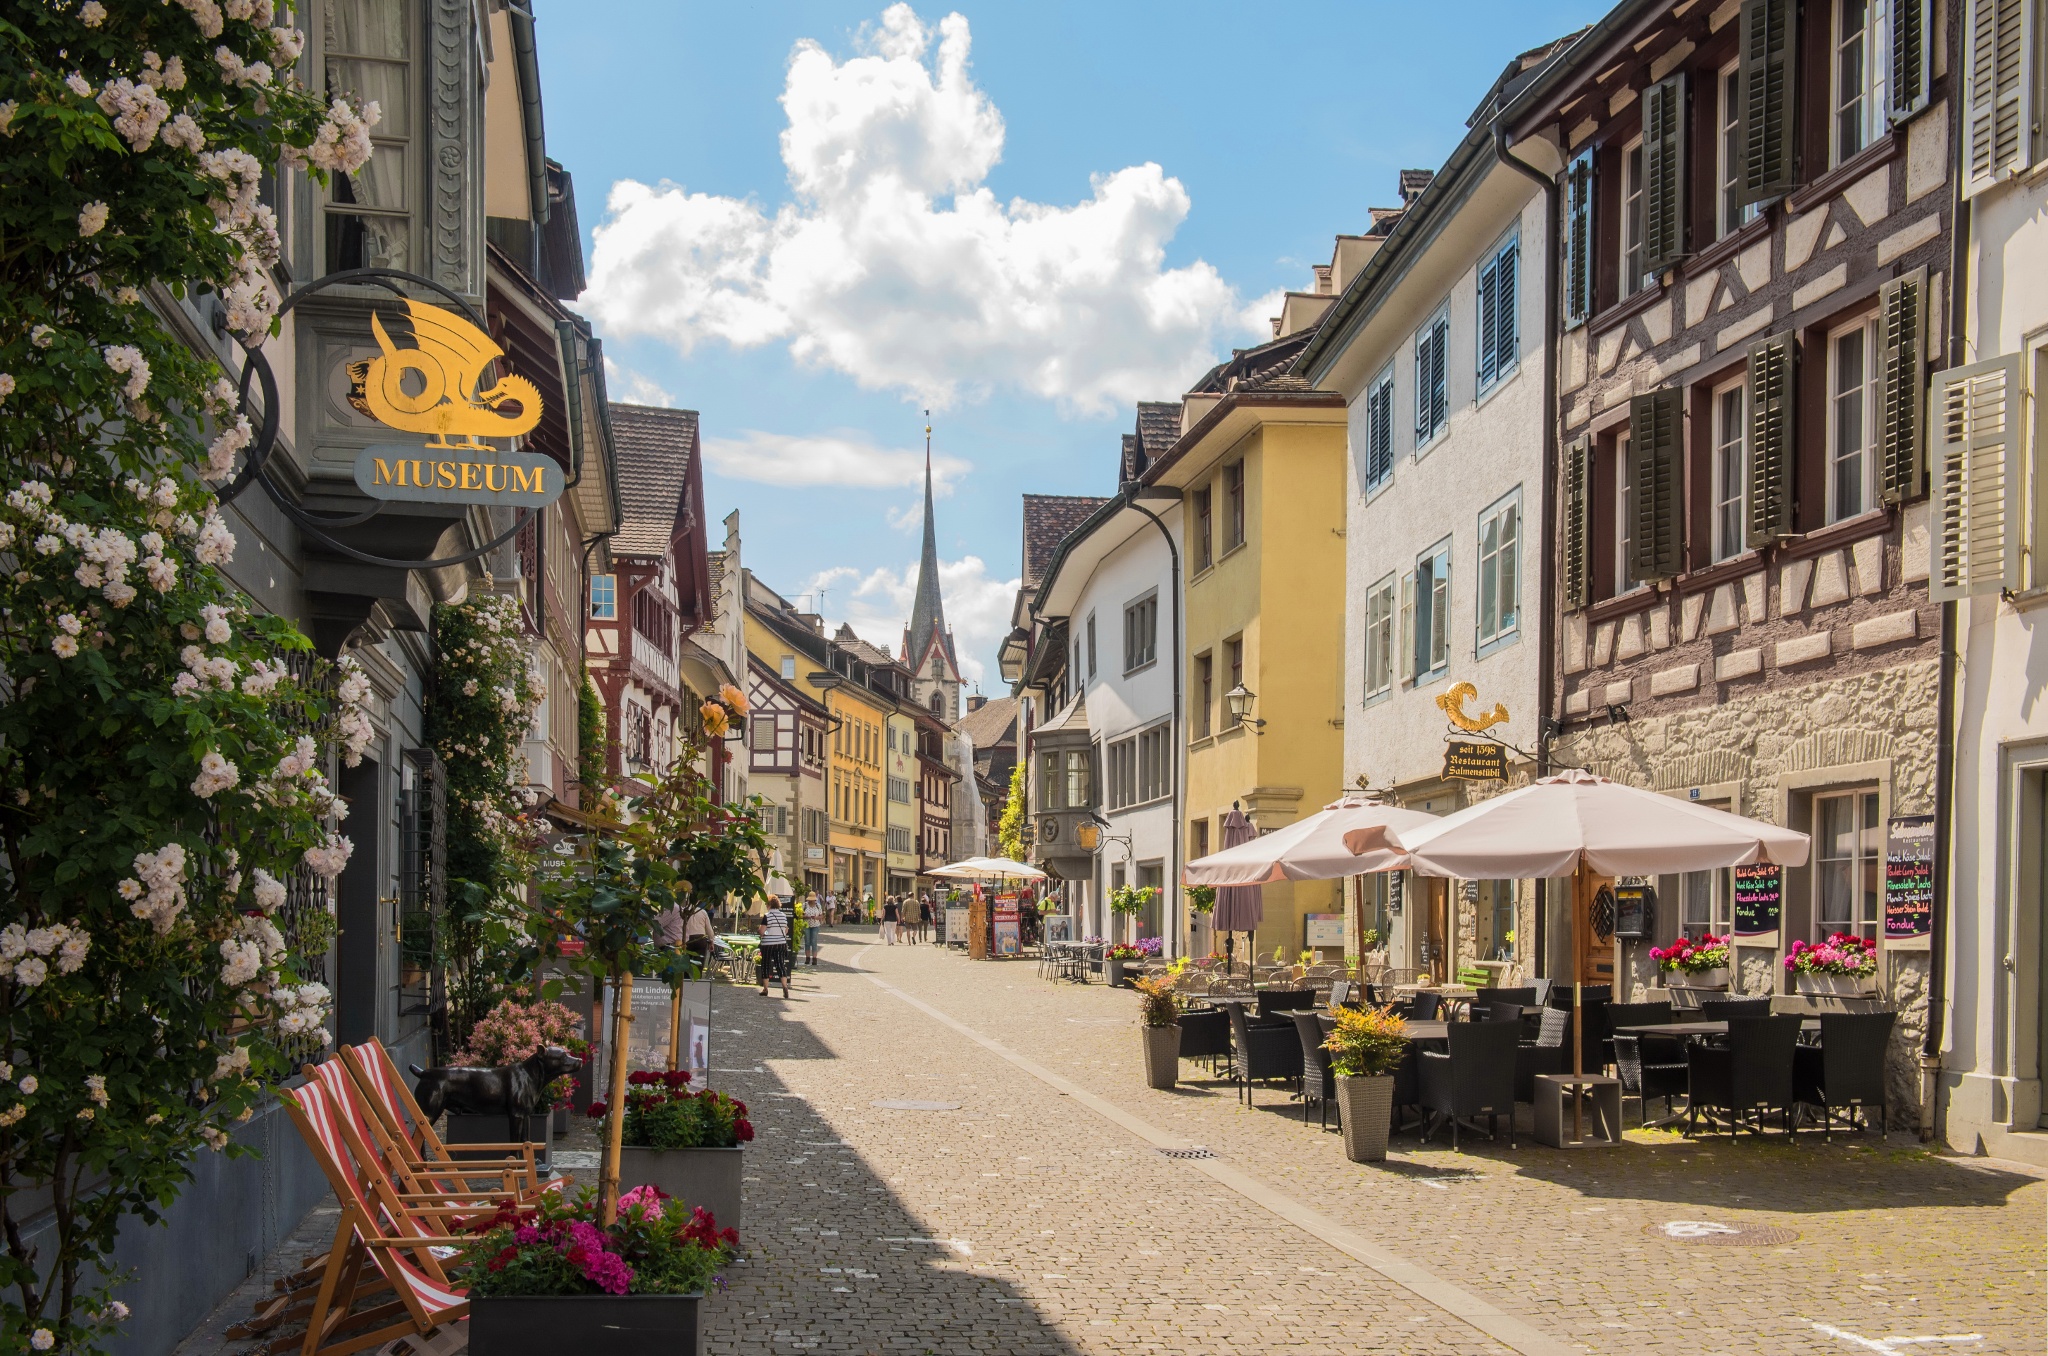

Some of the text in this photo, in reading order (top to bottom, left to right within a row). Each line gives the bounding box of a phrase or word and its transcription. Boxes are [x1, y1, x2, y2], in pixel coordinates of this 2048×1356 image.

[372, 458, 545, 493] MUSEUM
[1459, 745, 1473, 754] seit
[1450, 755, 1500, 767] Restaurant
[1449, 766, 1500, 778] Salmenstübli
[1916, 848, 1931, 861] Salat
[1914, 864, 1929, 875] Salat
[1736, 906, 1755, 917] Fondue
[1886, 917, 1915, 929] Fondue
